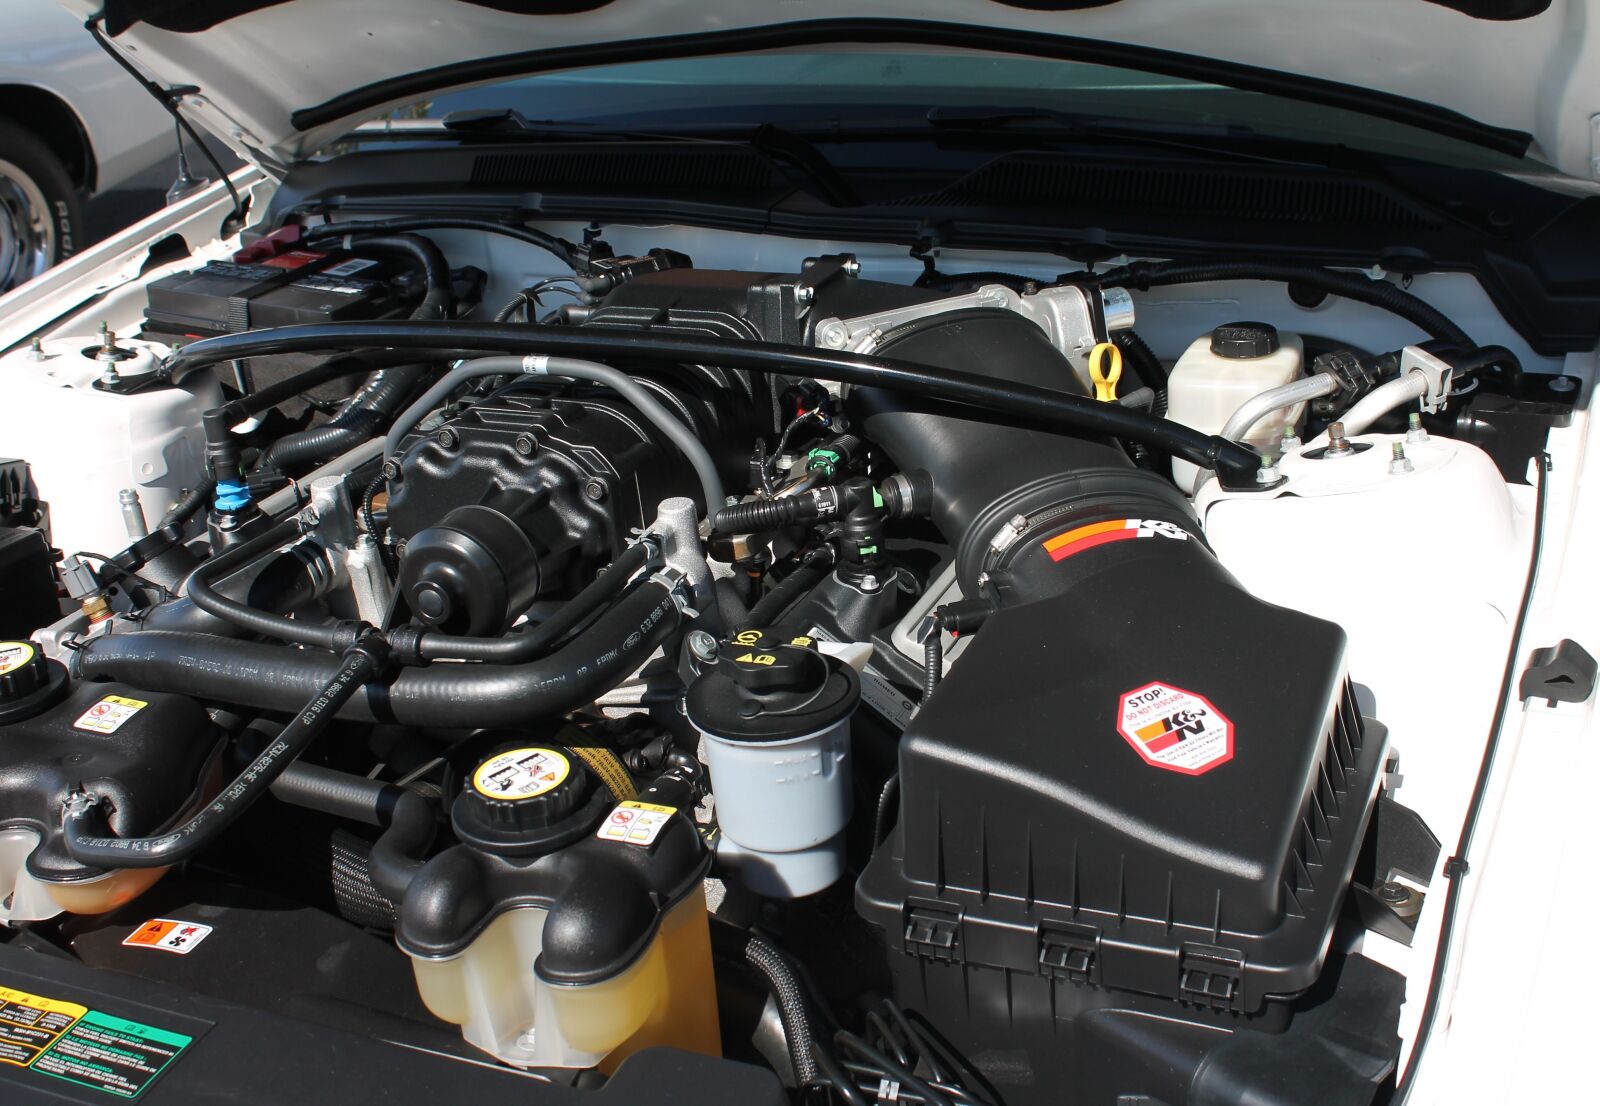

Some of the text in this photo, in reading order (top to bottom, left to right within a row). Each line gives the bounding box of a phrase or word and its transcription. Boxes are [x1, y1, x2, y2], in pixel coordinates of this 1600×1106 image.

[1125, 519, 1188, 541] K&N
[1126, 693, 1185, 721] DO NOT DISCARD
[1128, 687, 1167, 708] STOP!
[1161, 708, 1207, 742] K&N
